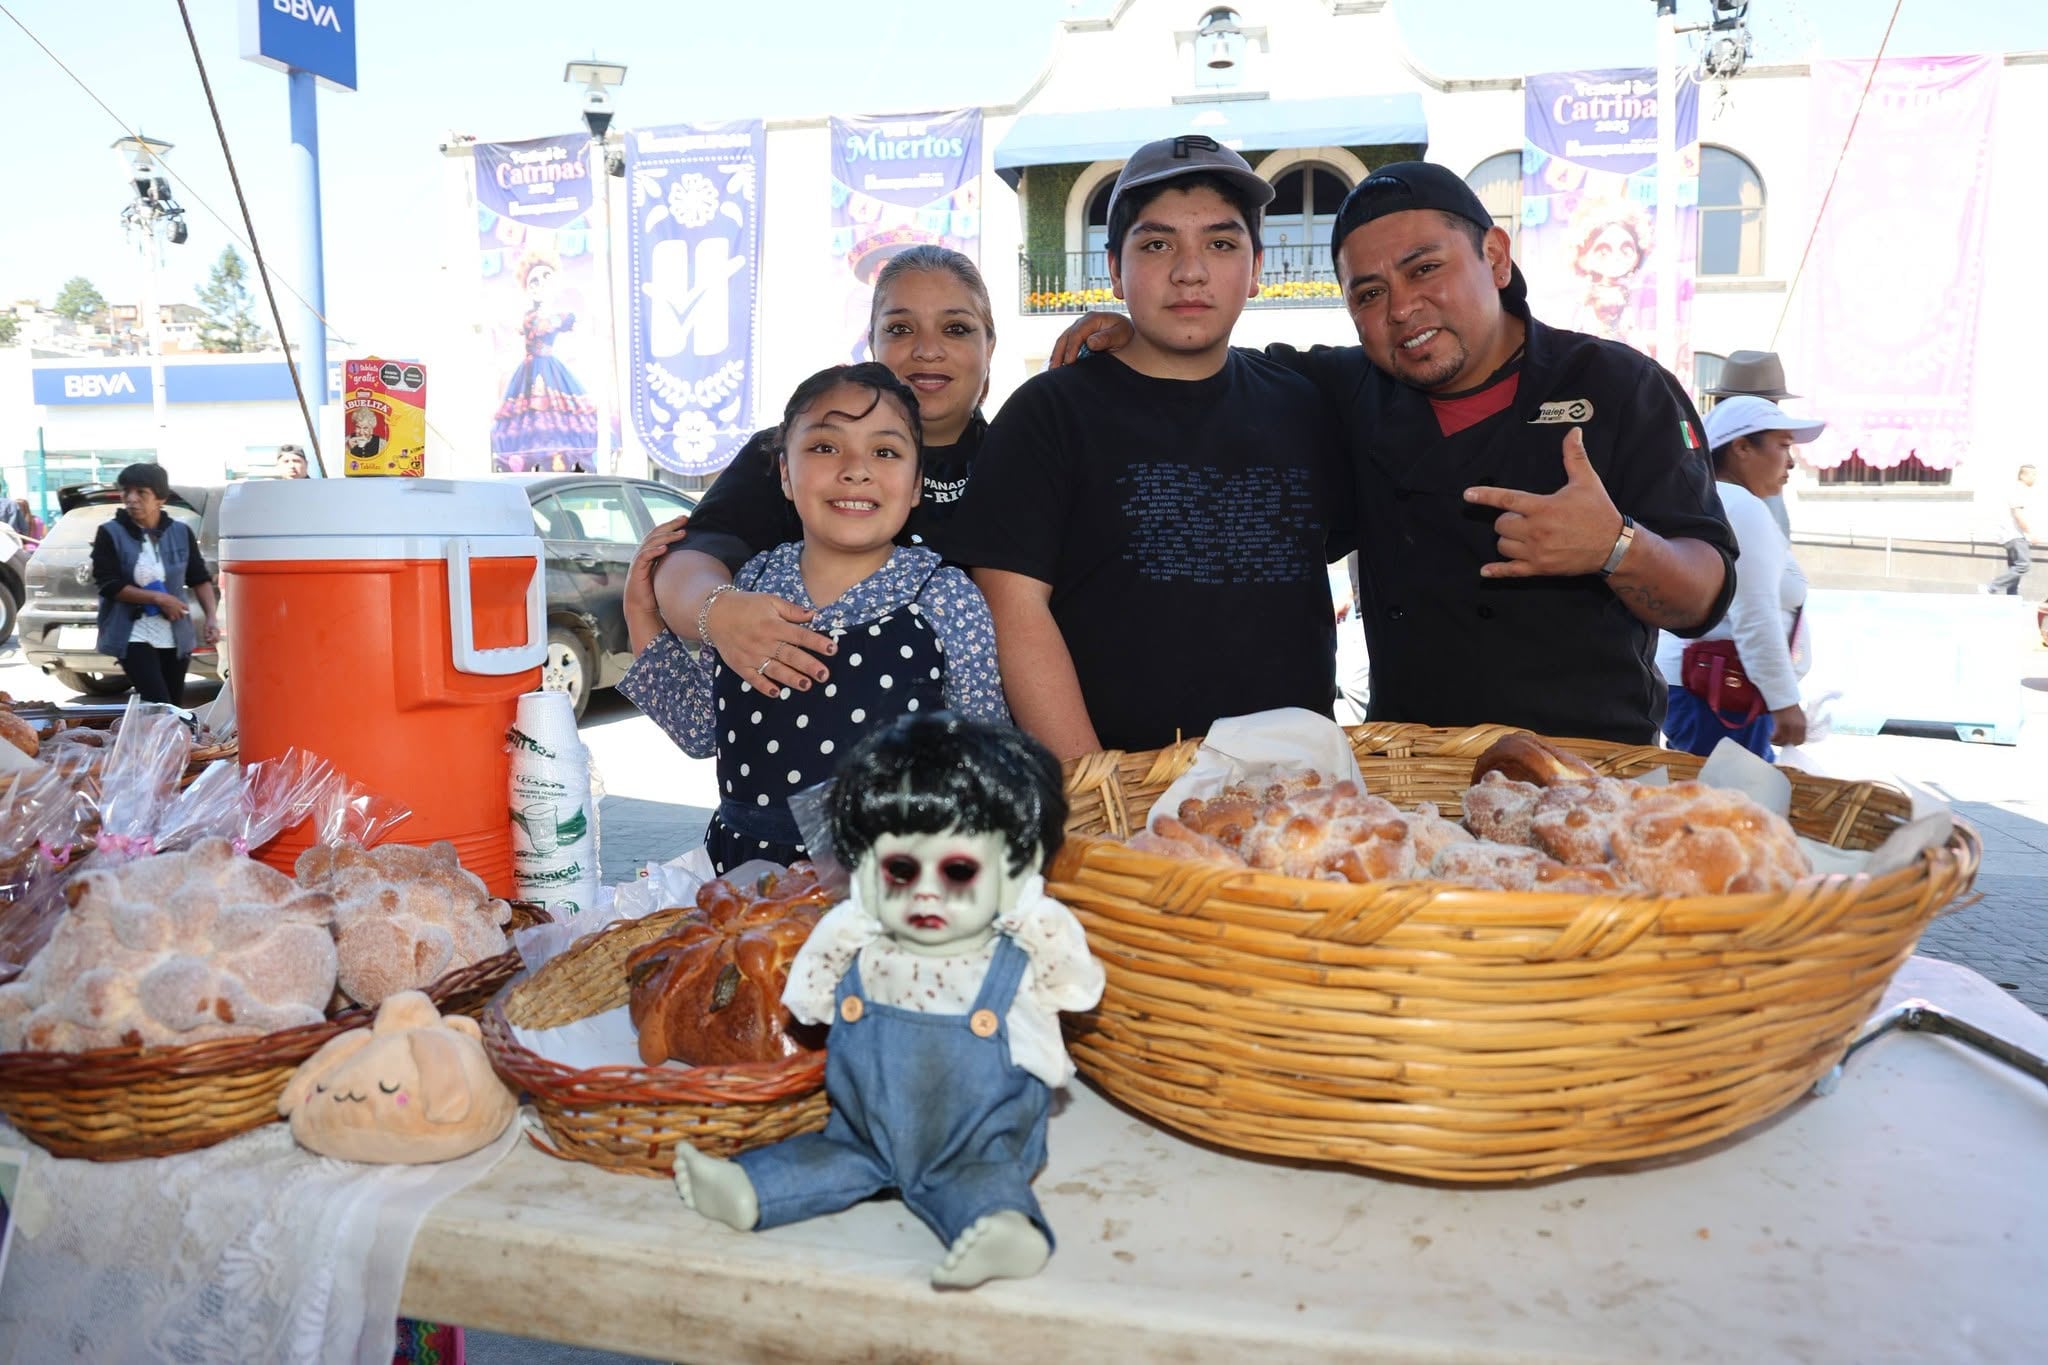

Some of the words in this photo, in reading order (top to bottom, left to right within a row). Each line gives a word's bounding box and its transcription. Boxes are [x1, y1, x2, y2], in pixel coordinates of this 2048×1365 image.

[273, 0, 342, 33] BBVA
[1553, 92, 1658, 125] Catrina
[845, 128, 964, 163] Muertos
[496, 161, 586, 190] Catrinas
[64, 371, 136, 398] BBVA
[353, 372, 376, 385] gratis
[344, 399, 388, 413] ABUELITA
[1540, 407, 1566, 416] nalep
[924, 477, 969, 491] PANAD
